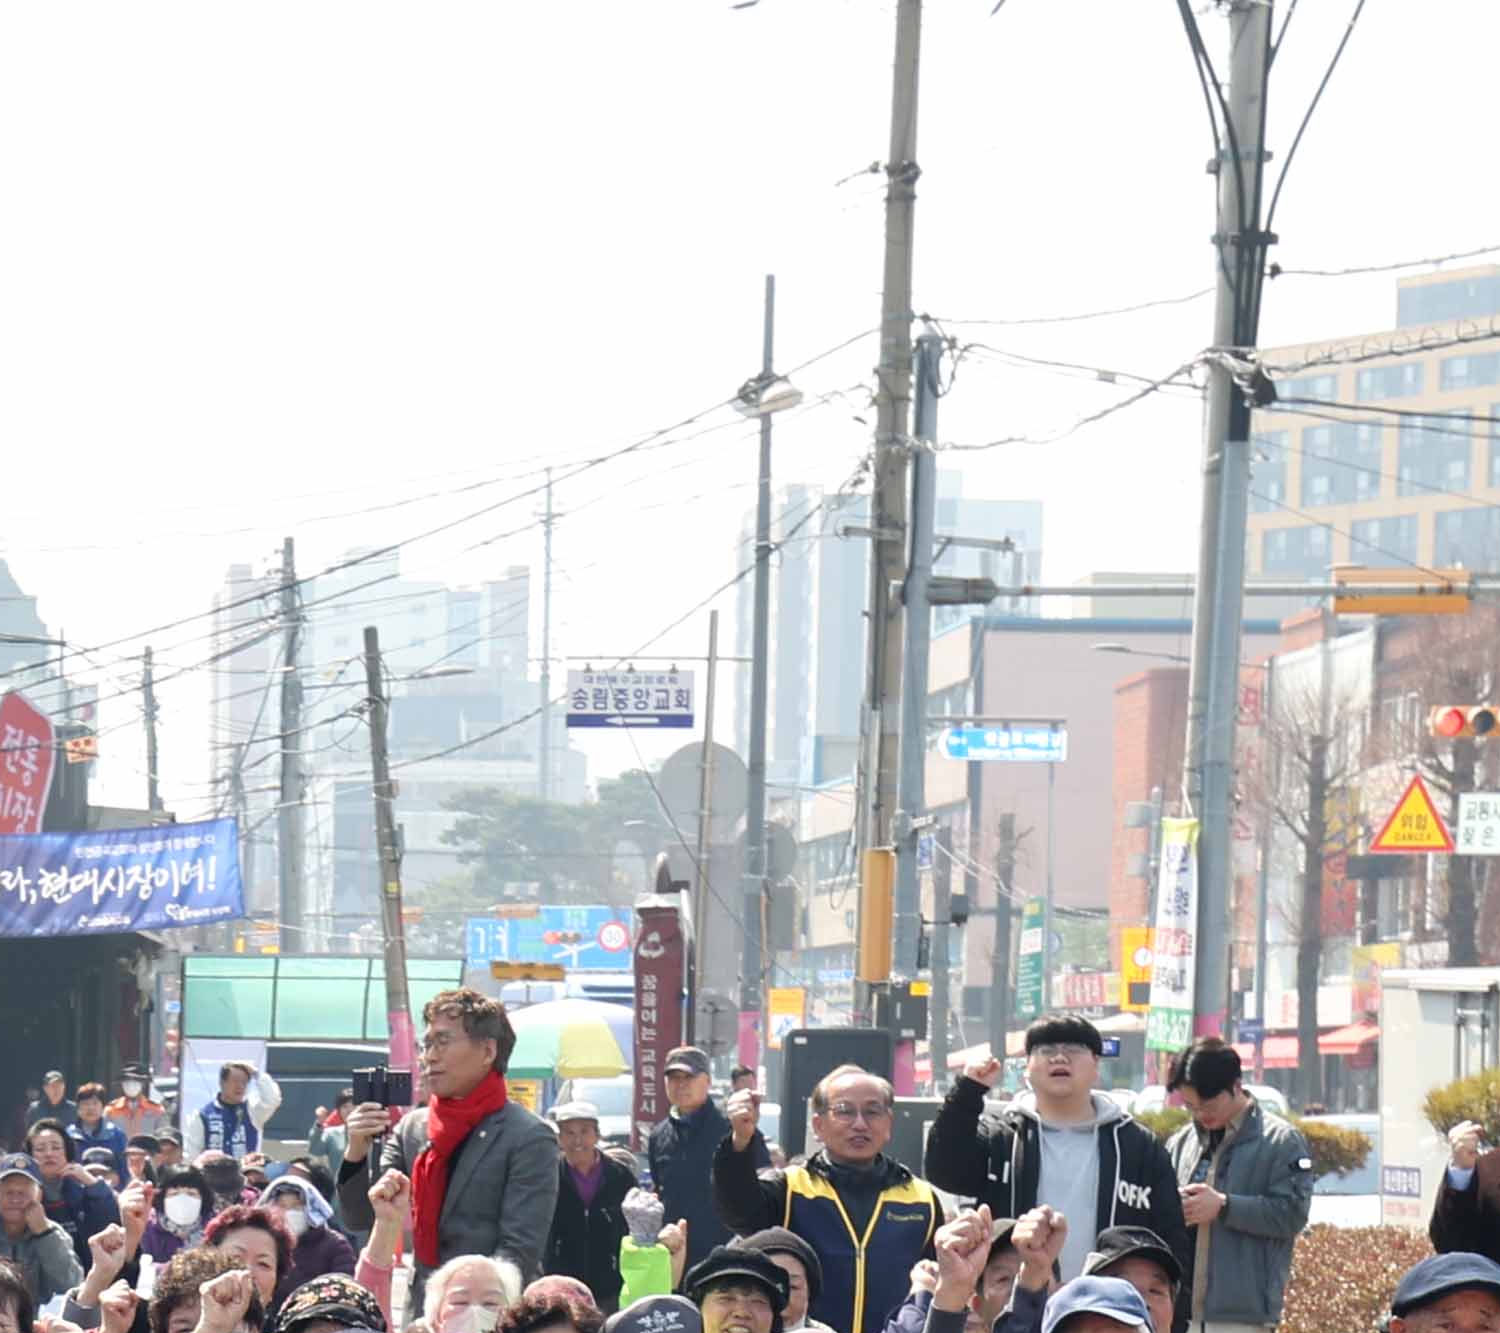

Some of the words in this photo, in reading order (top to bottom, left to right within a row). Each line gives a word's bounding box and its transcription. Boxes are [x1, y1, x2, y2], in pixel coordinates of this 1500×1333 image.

[572, 688, 690, 710] 송림중앙교회
[1401, 813, 1428, 831] 위험
[1117, 1180, 1152, 1210] OFK
